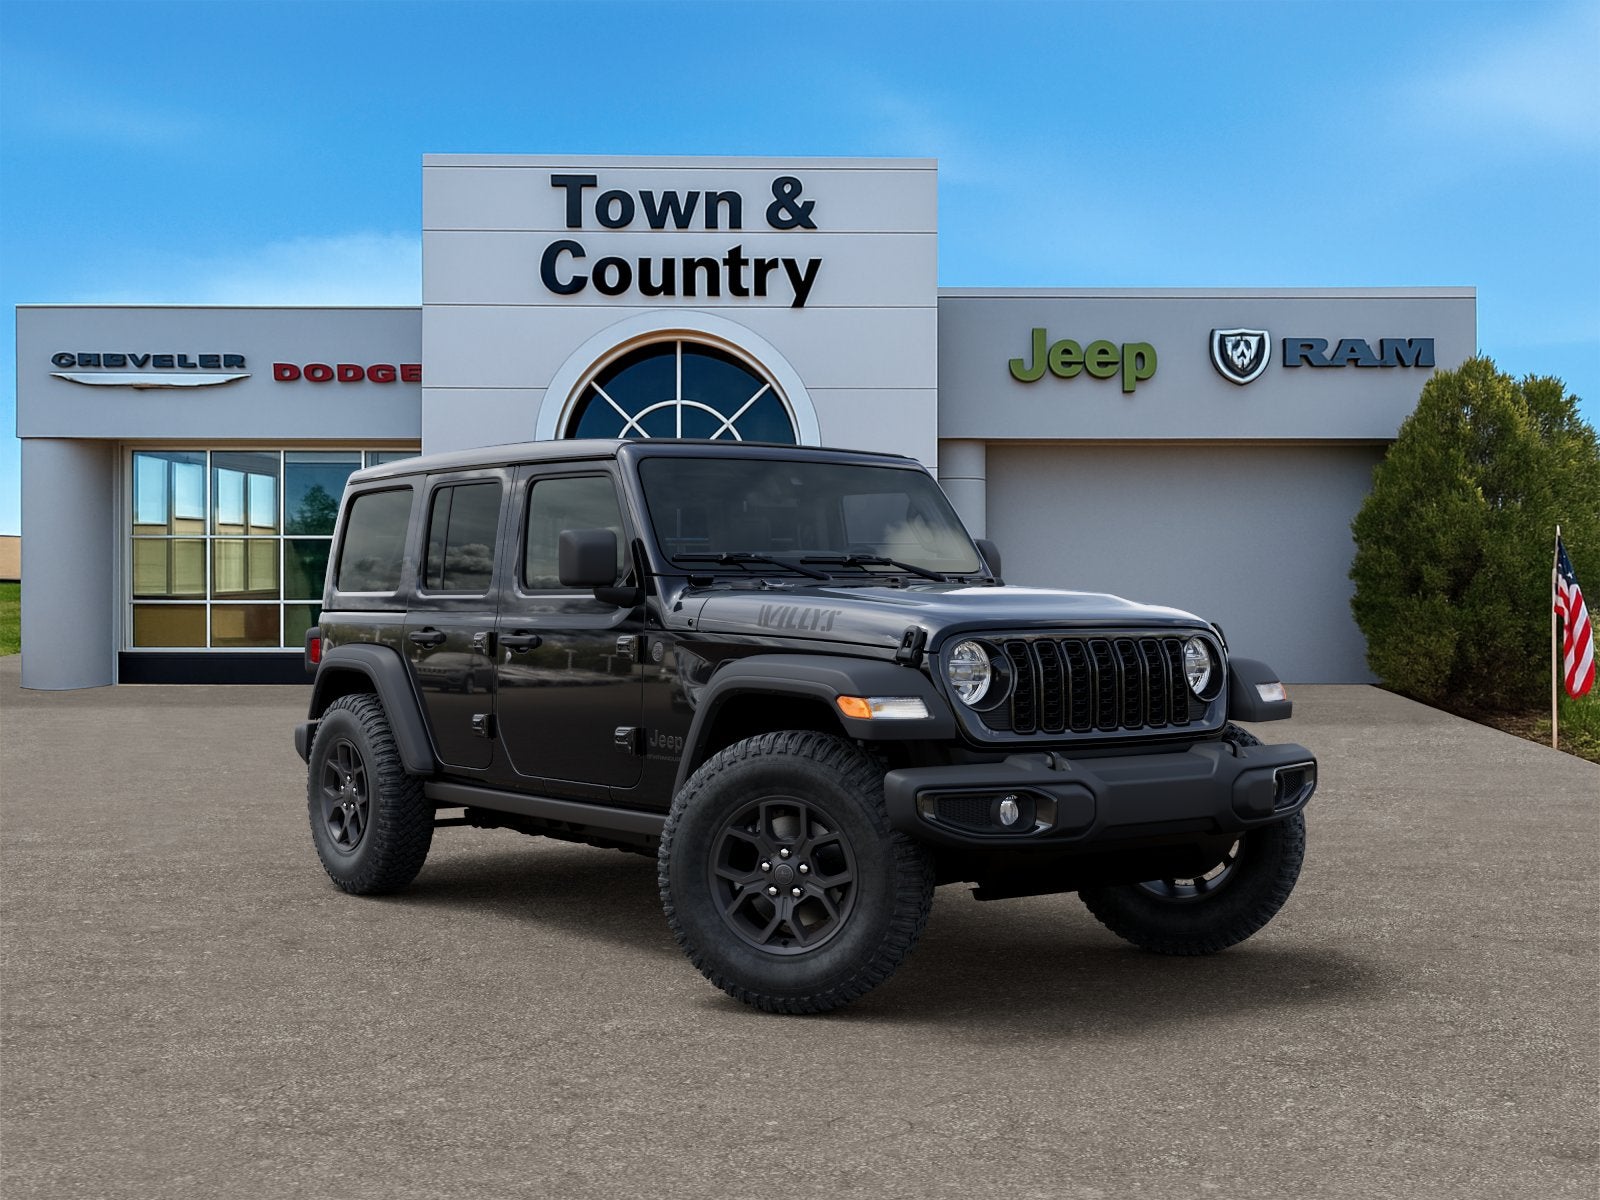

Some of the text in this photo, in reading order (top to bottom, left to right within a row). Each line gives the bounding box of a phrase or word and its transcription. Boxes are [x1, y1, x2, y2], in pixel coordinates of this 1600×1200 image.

[550, 174, 818, 229] Town &
[539, 240, 822, 308] Country
[272, 362, 422, 383] DODGE
[1008, 328, 1158, 393] Jeep
[1282, 338, 1435, 368] RAM
[649, 729, 683, 754] Jeep
